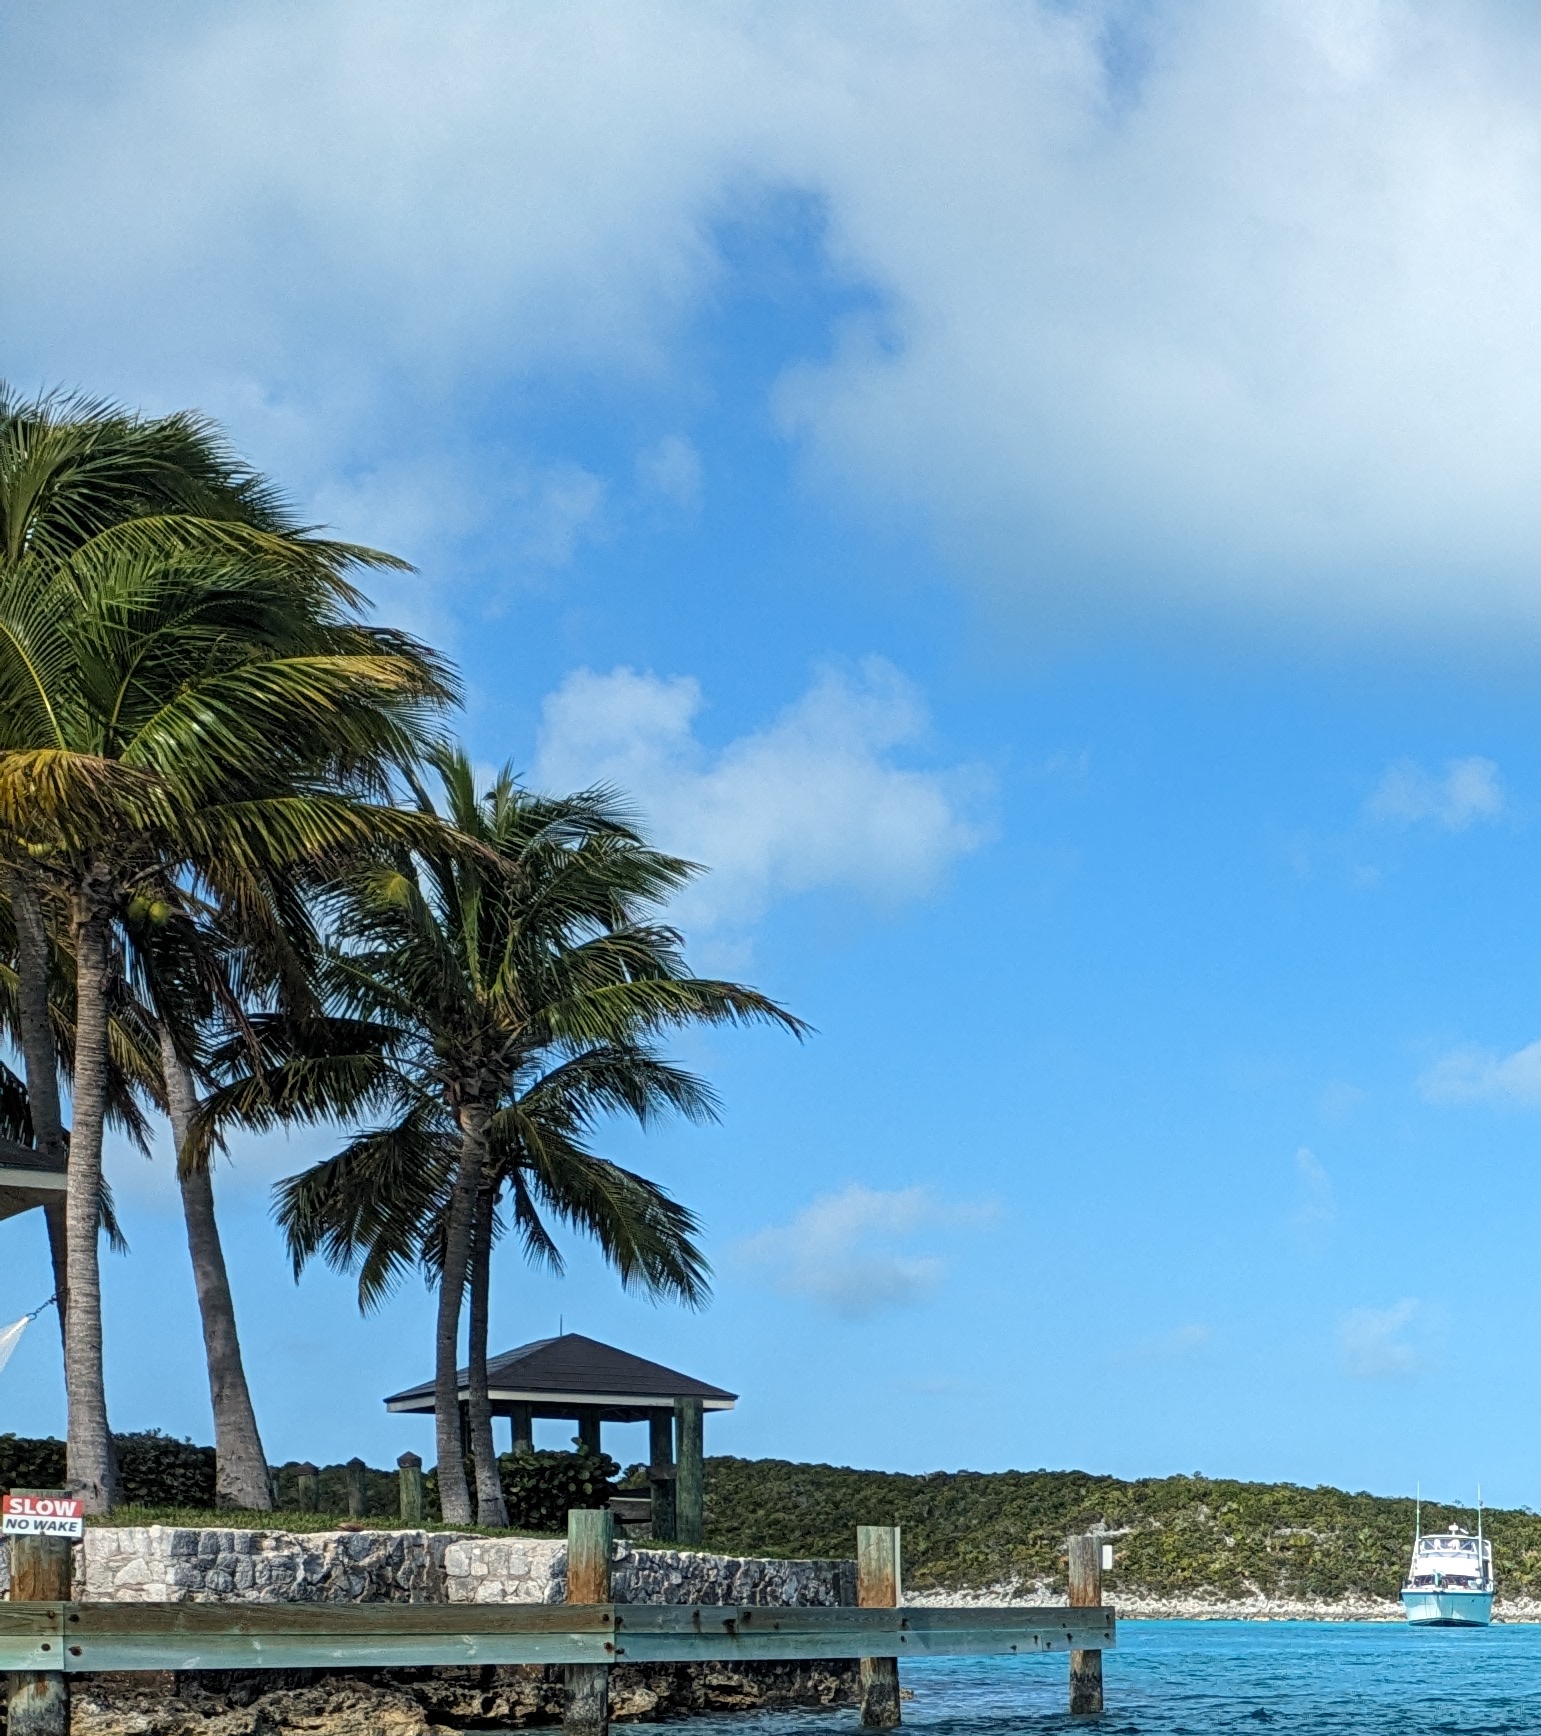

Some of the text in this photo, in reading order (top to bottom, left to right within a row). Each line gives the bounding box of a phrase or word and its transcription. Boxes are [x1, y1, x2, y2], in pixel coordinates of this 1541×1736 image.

[9, 1498, 77, 1517] SLOW
[5, 1518, 78, 1532] NO WAKE
